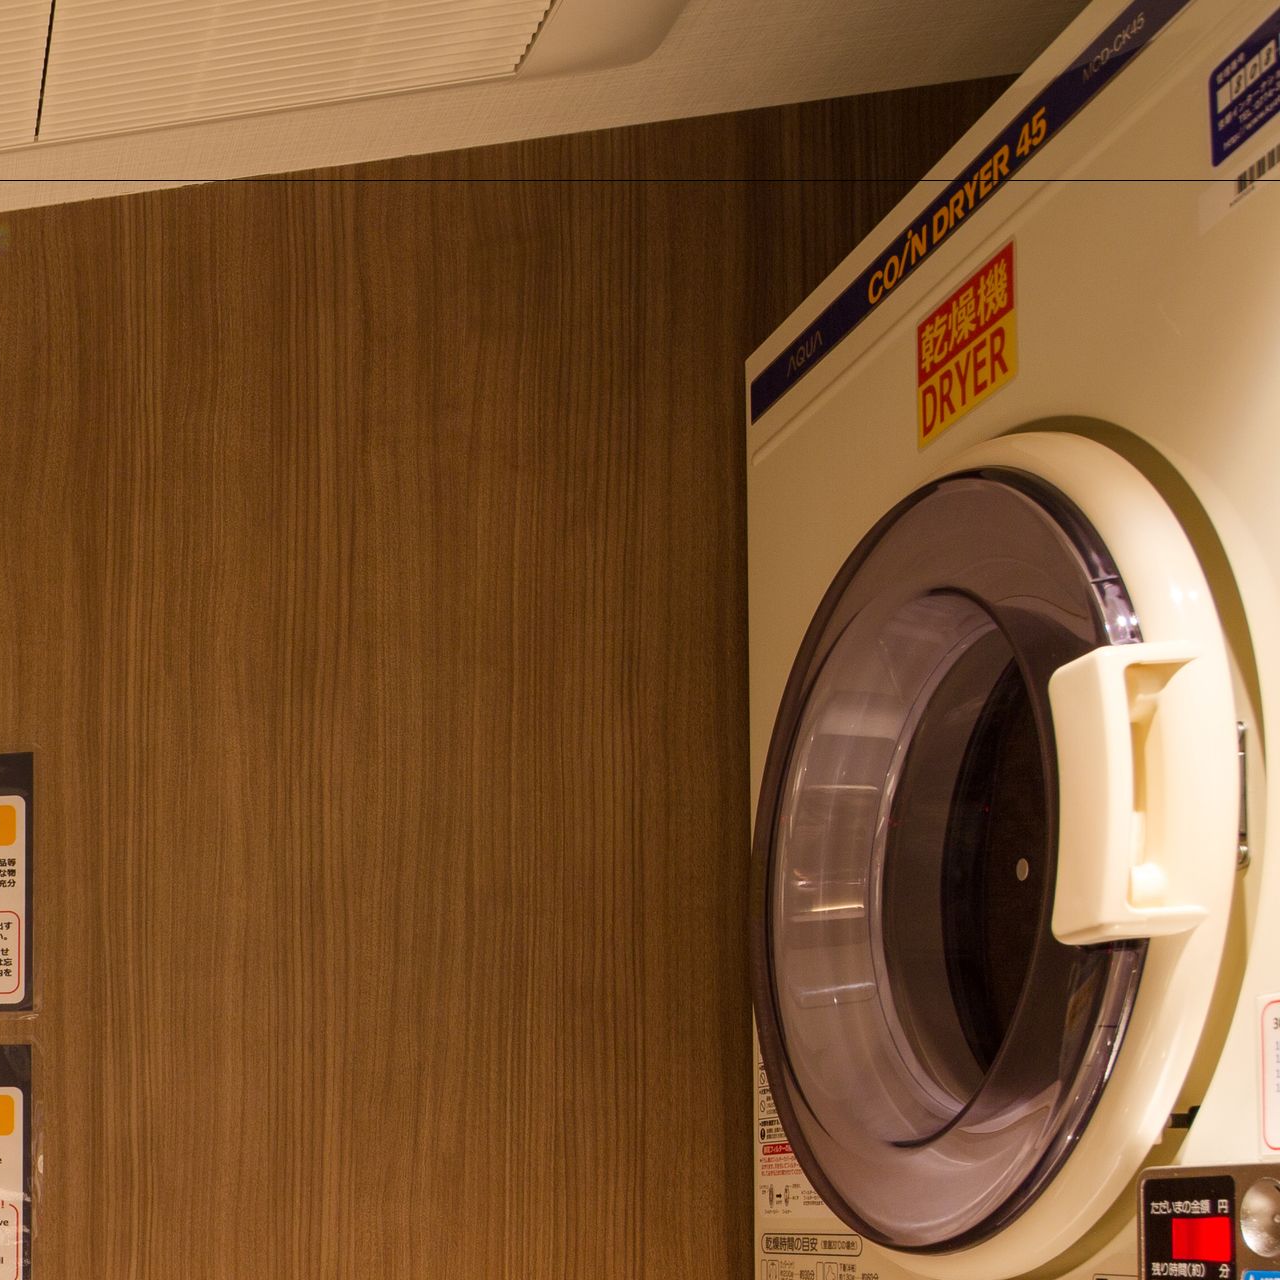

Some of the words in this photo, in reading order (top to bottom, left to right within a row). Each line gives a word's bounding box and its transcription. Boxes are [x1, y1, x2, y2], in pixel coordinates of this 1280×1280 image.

[787, 329, 823, 377] AQUA
[932, 145, 1009, 244] DRYER
[1016, 107, 1047, 158] 45
[922, 259, 1007, 372] 乾燥機
[922, 327, 1008, 438] DRYER
[1151, 1199, 1211, 1214] ただいまの金額
[1218, 1199, 1228, 1213] 円
[765, 1237, 818, 1252] 乾燥時間の目安
[1219, 1264, 1230, 1278] 分
